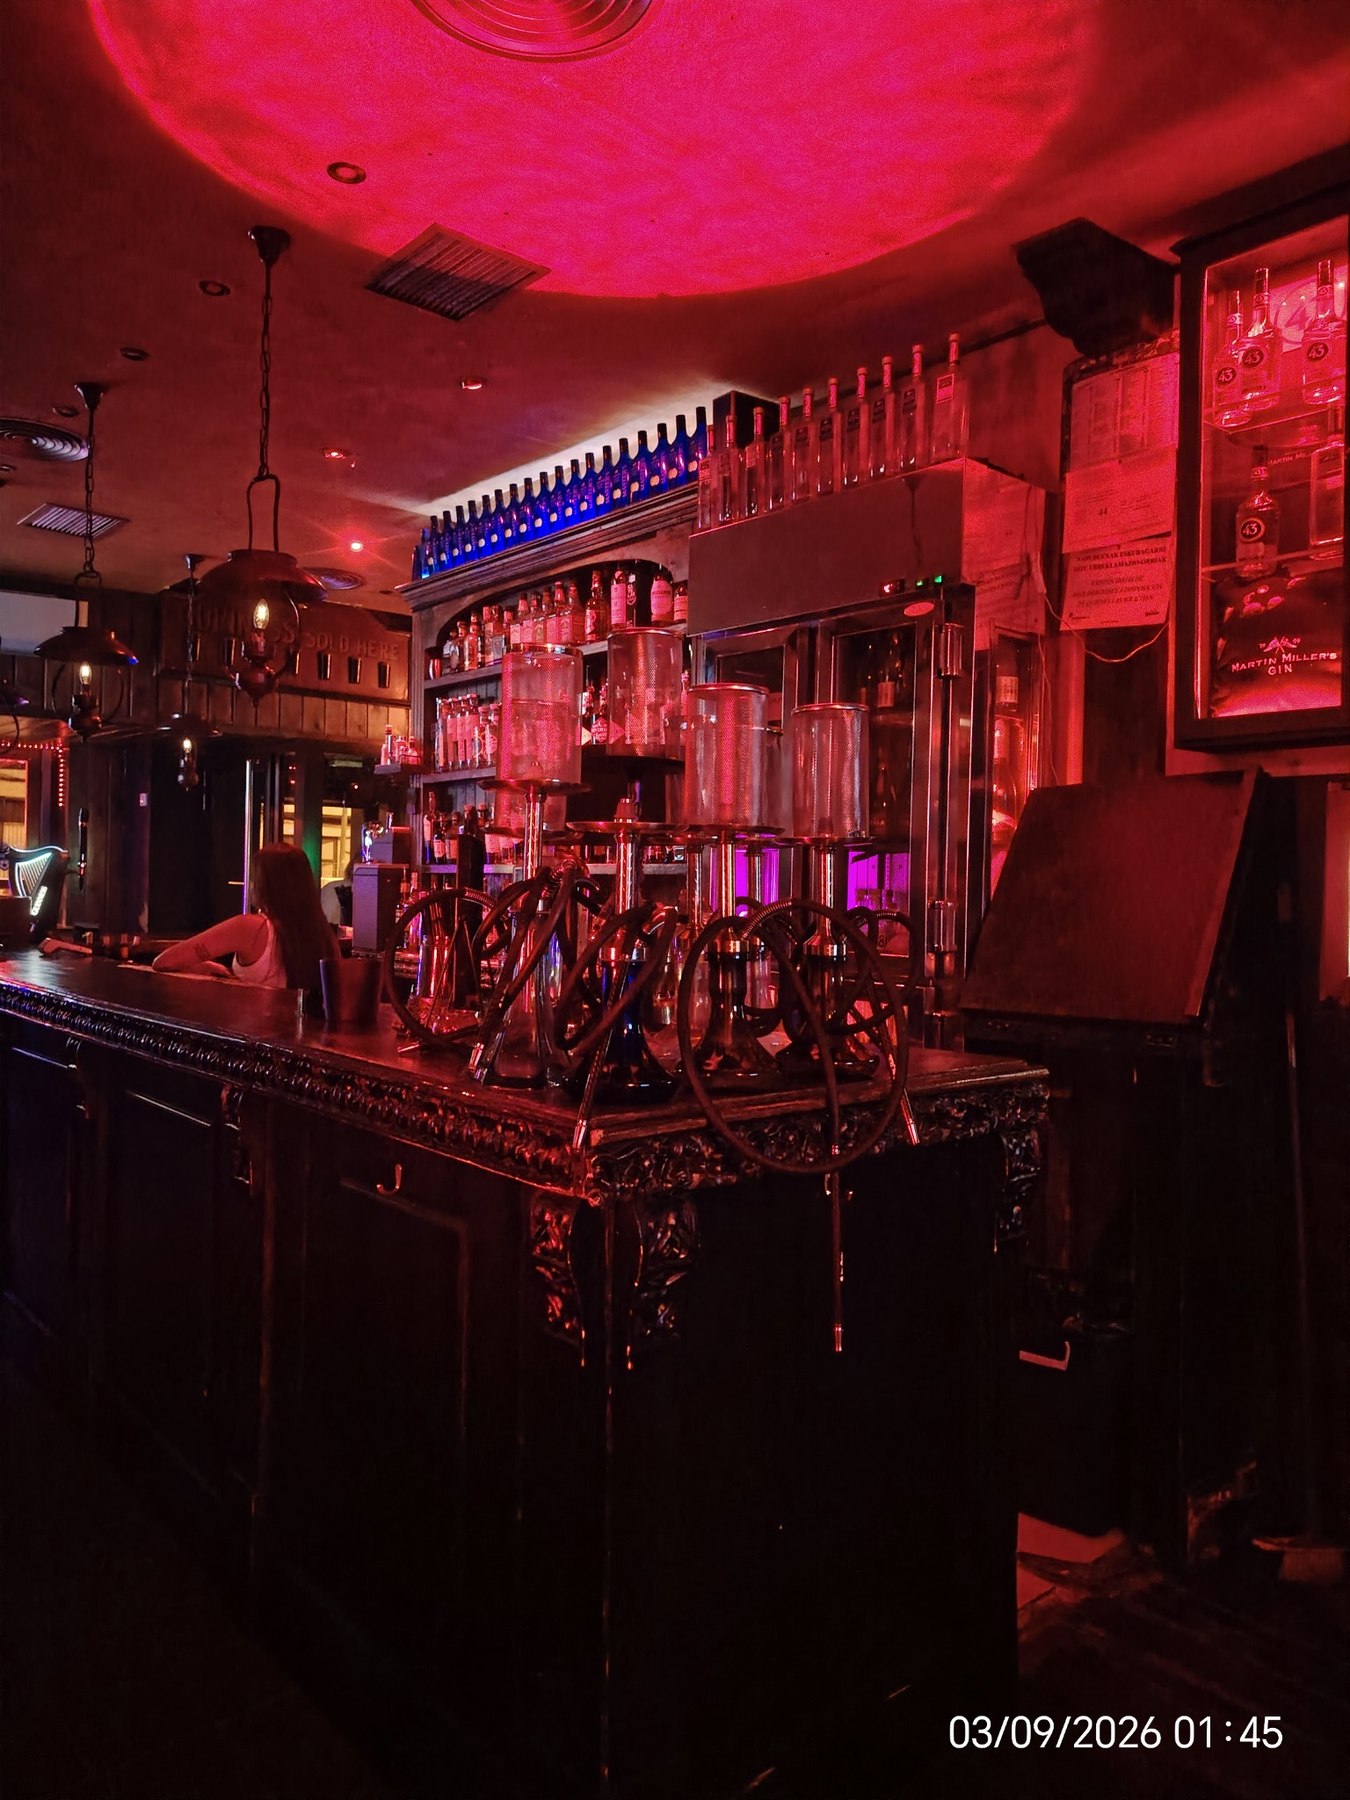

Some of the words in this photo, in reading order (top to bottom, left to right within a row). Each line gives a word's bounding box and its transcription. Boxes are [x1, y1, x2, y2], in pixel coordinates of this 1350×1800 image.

[1244, 351, 1261, 365] 43
[1307, 344, 1325, 359] 43
[1219, 368, 1234, 382] 43
[1243, 523, 1258, 536] 43
[305, 630, 349, 652] SOLD
[357, 640, 399, 660] HERE
[1231, 658, 1277, 673] MARTIN
[1267, 663, 1293, 676] GIN
